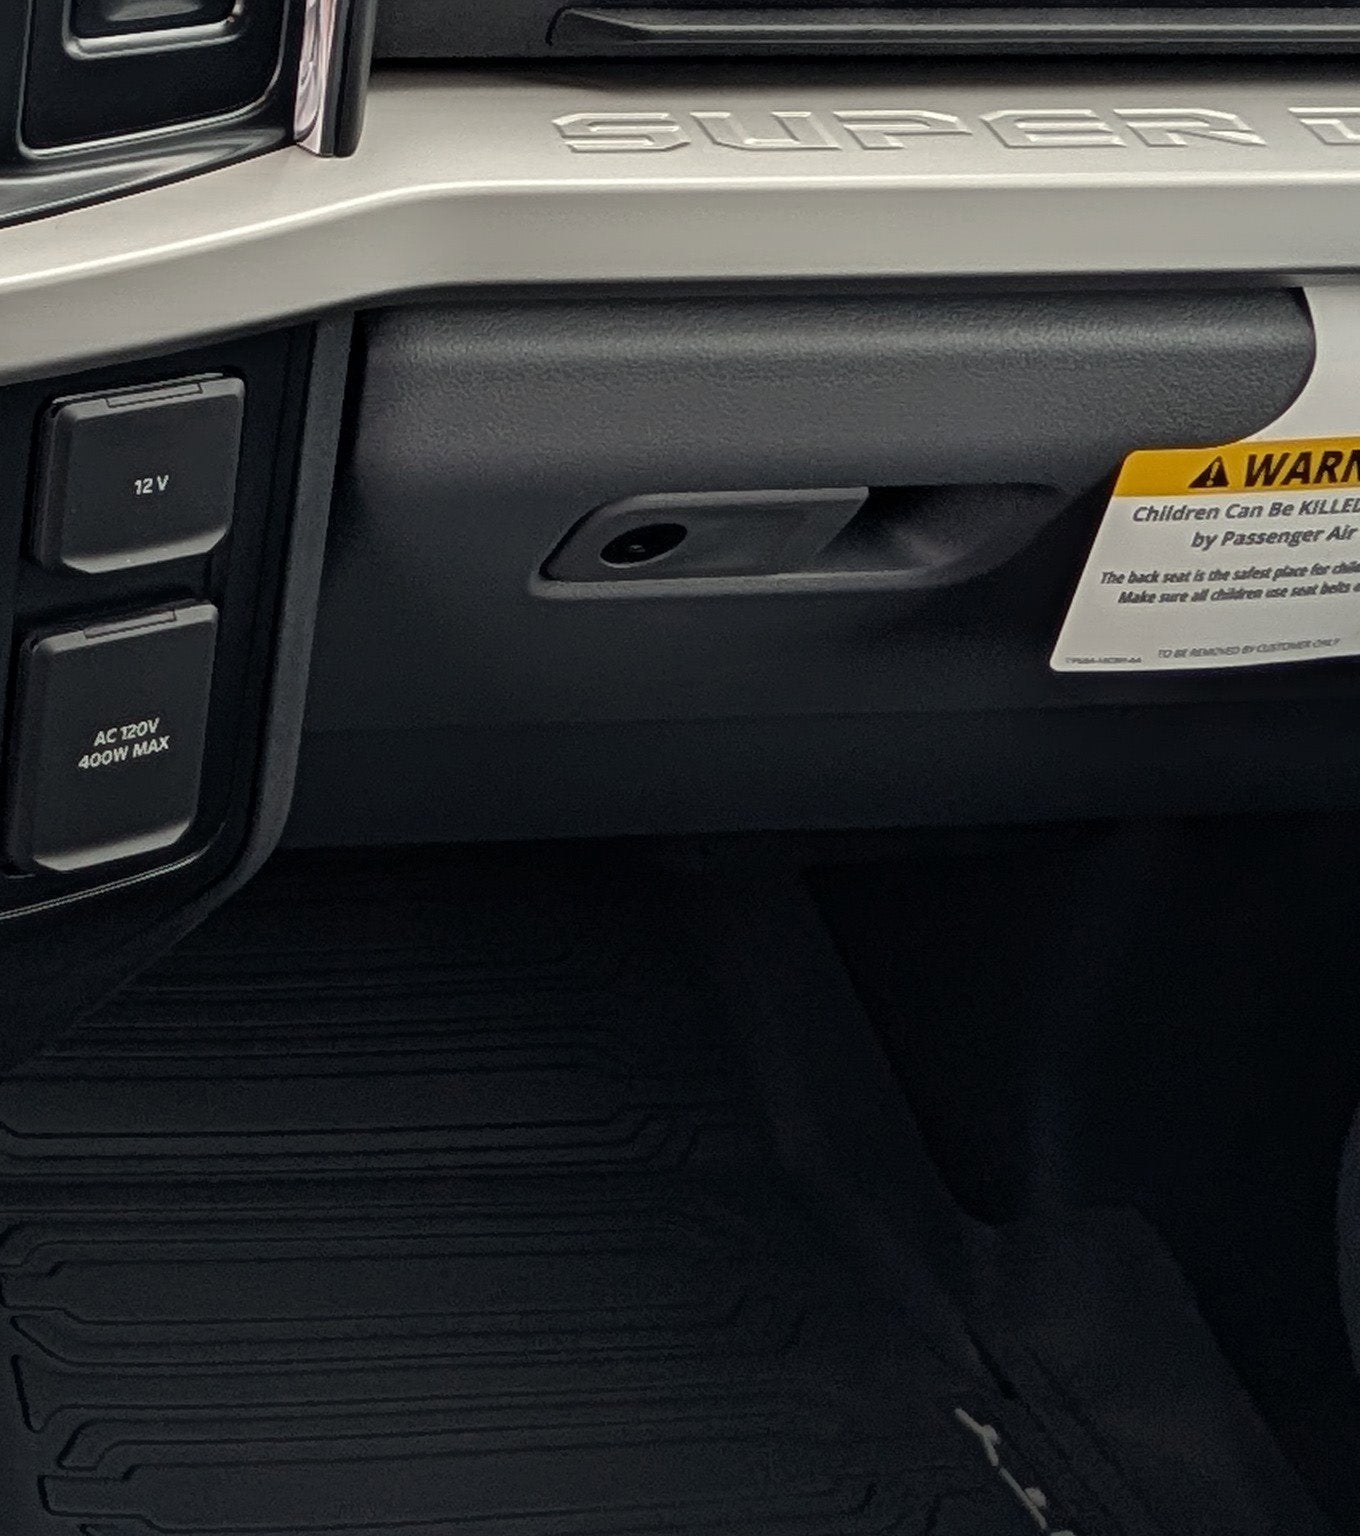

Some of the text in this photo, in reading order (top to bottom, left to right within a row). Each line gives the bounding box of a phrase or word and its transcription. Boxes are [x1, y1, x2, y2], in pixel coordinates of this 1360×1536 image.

[550, 109, 1268, 152] SUPER
[134, 475, 169, 495] 12 V
[1132, 504, 1220, 522] Children
[1225, 503, 1263, 519] Can
[1268, 501, 1295, 517] Be
[1191, 524, 1358, 551] by Passenger Air
[1100, 571, 1125, 584] The
[1127, 570, 1159, 584] back
[1118, 590, 1156, 604] Make
[94, 717, 160, 747] AC 120V
[79, 735, 171, 769] 400W MAX
